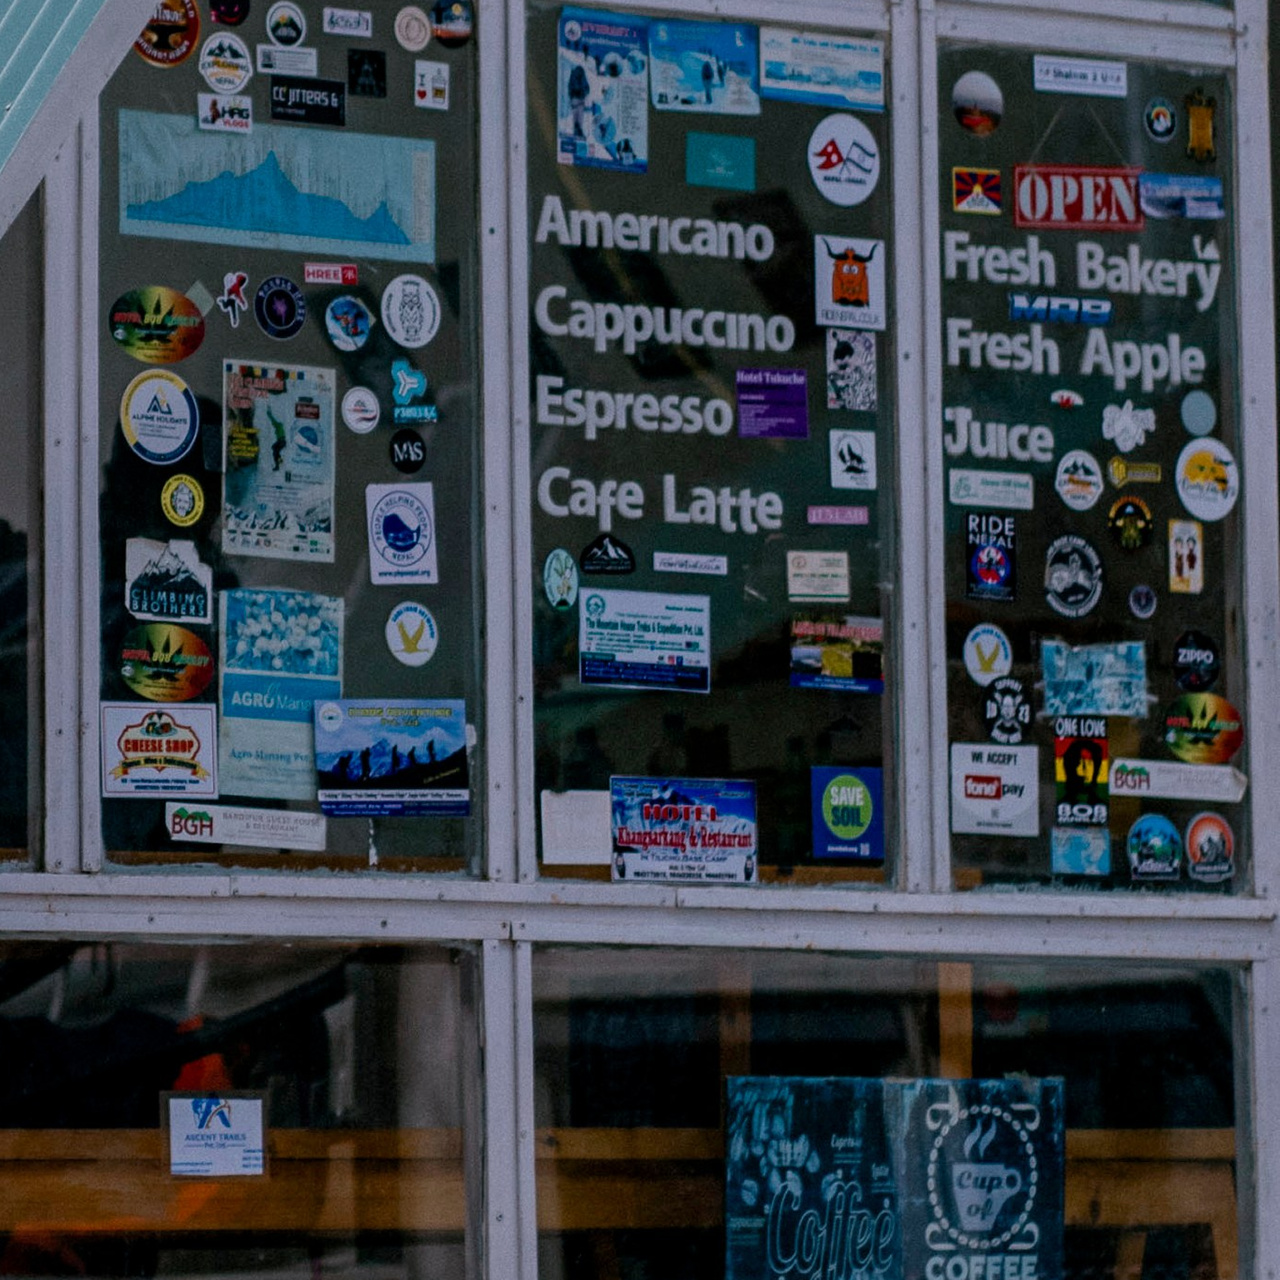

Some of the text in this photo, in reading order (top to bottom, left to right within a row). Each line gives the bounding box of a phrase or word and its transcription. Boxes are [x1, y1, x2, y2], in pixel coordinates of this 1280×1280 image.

[288, 87, 329, 107] JITTERS
[331, 93, 338, 107] &
[1019, 173, 1139, 222] OPEN
[535, 195, 775, 261] Americano
[944, 231, 1220, 313] Fresh Bakery
[534, 285, 796, 355] Cappuccino
[946, 318, 1206, 393] Fresh Apple
[736, 370, 763, 384] Hotel
[536, 374, 734, 441] Espresso
[944, 407, 1055, 462] Juice
[537, 466, 784, 535] Cafe Latte
[375, 495, 428, 541] PEOPLE HELPING PEOPLE
[968, 514, 1015, 536] RIDE
[968, 533, 1014, 549] NEPAL
[392, 551, 414, 561] NEPAL
[131, 587, 205, 606] CLIMBING
[131, 599, 205, 616] BROTHERS
[1178, 648, 1214, 664] ZIPPO
[231, 690, 312, 711] AGRO Mana
[1055, 718, 1106, 740] ONE LOVE
[123, 738, 194, 754] CHEESE SHOP
[972, 751, 1018, 766] WE ACCEPT
[1114, 770, 1150, 791] BGH
[830, 786, 864, 806] SAVE
[642, 803, 718, 822] HOTEL
[831, 806, 864, 827] SOIL
[1057, 803, 1108, 819] BOB
[171, 811, 214, 838] BGH
[689, 826, 699, 848] &
[700, 826, 752, 848] Restaurant
[184, 1133, 247, 1141] ASCENT TRAILS
[966, 1195, 996, 1221] of
